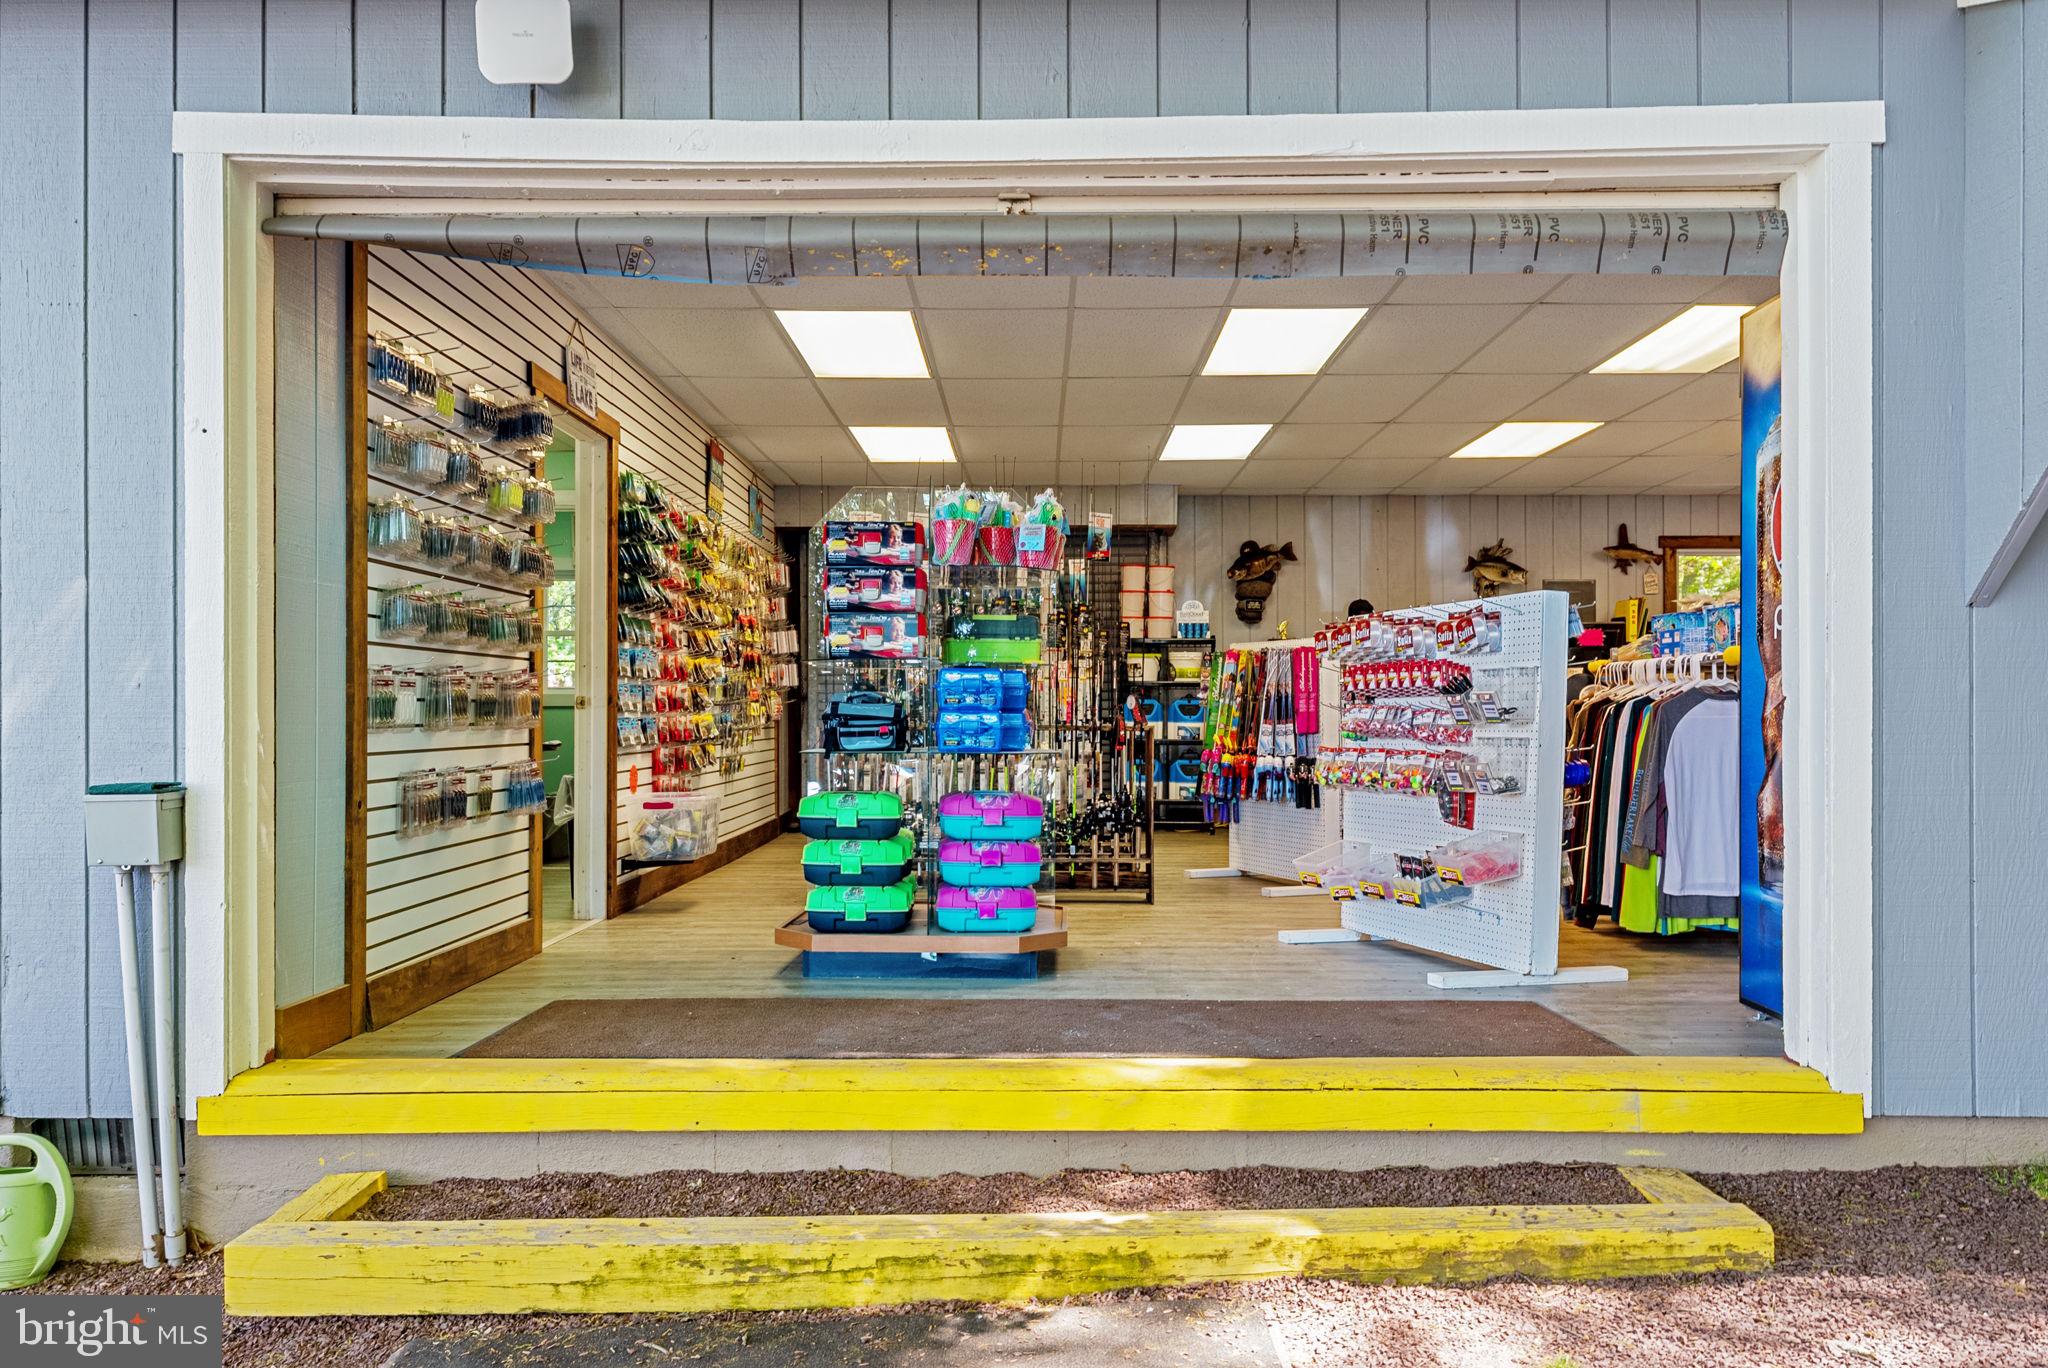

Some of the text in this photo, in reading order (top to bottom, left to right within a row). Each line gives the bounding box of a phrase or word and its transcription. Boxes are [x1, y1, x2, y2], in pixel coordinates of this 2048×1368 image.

[1418, 218, 1429, 245] PVC
[1548, 217, 1559, 242] PVC
[1677, 216, 1688, 243] PVC
[628, 252, 638, 270] UPC
[754, 256, 766, 276] UPC
[575, 381, 594, 412] LAKE
